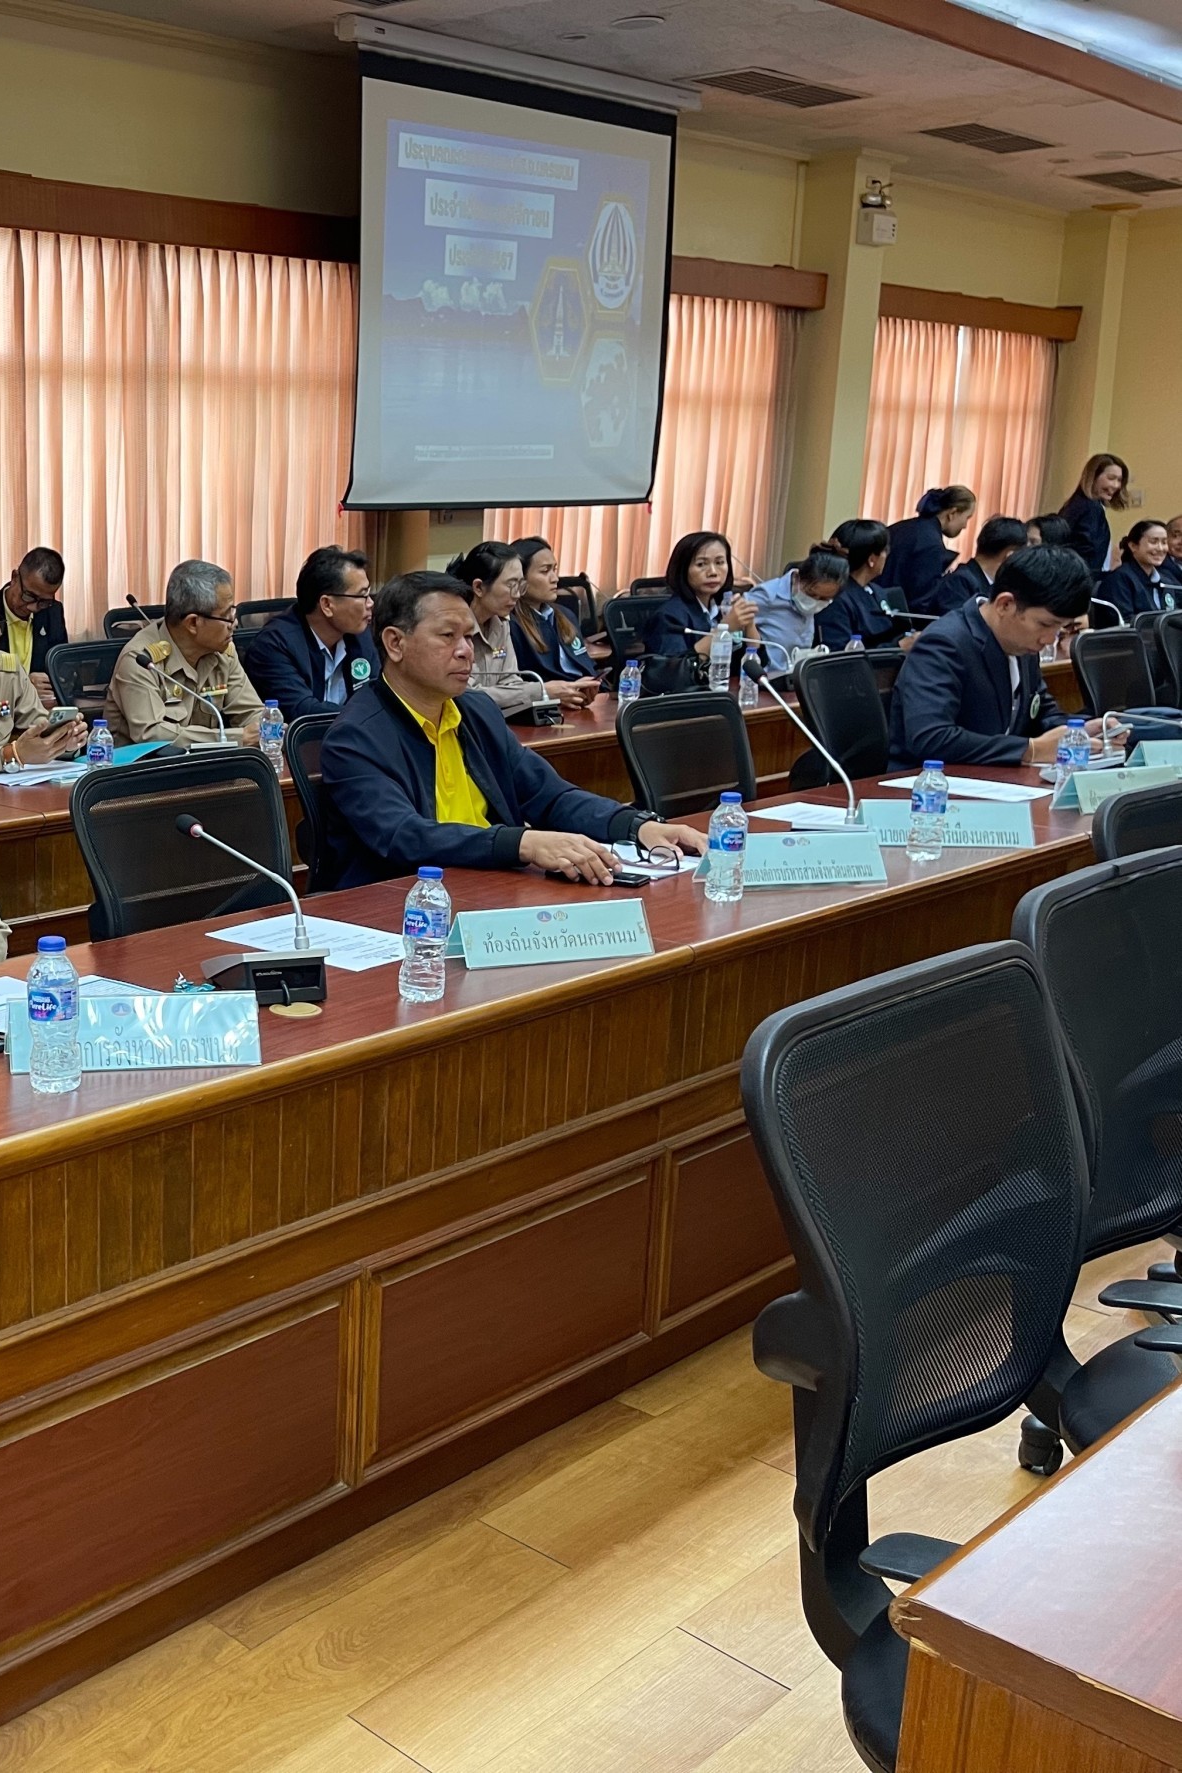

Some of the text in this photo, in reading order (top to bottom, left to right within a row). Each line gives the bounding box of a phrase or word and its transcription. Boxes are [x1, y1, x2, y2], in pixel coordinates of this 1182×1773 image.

[482, 926, 637, 954] ท้องถิ่นจังหวัดนครพนม
